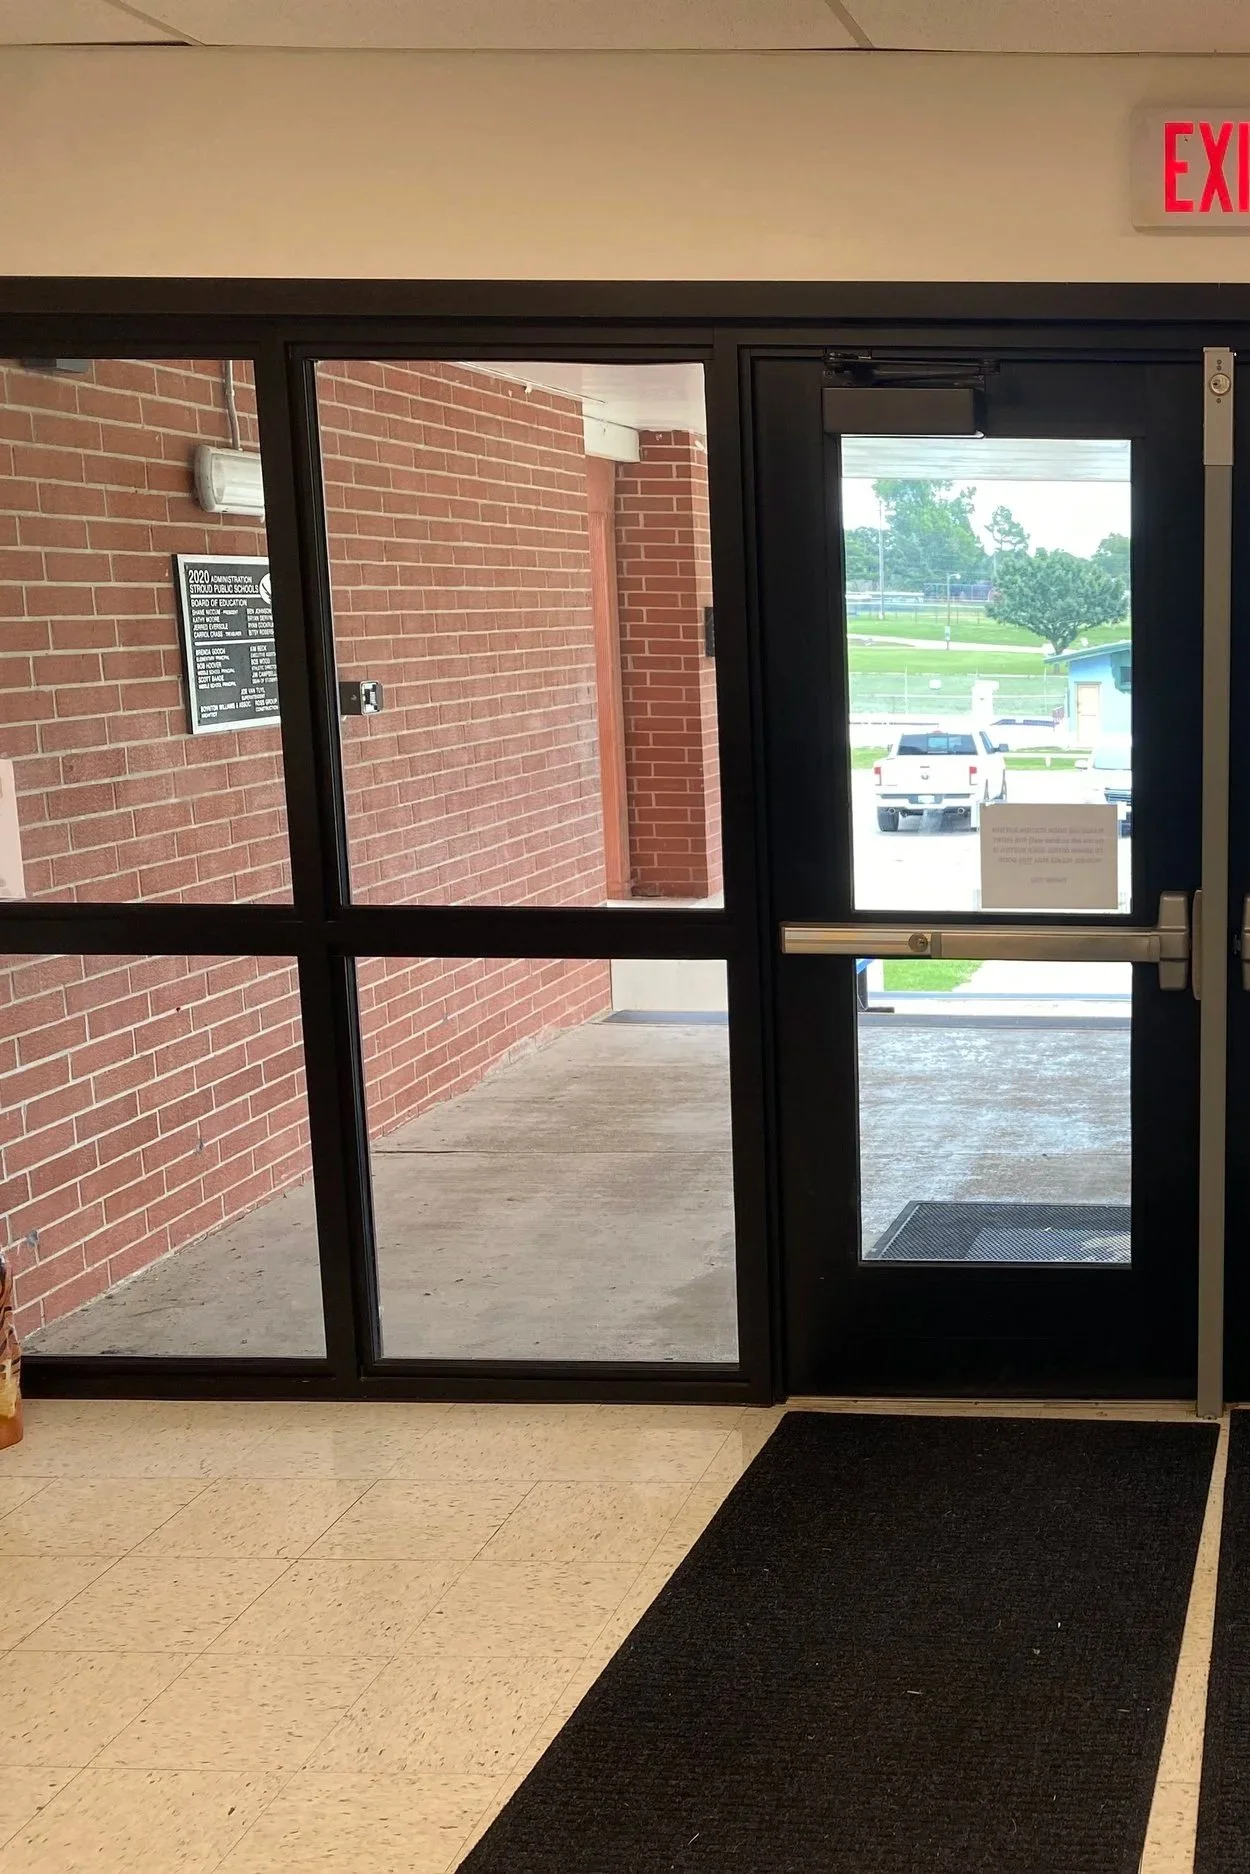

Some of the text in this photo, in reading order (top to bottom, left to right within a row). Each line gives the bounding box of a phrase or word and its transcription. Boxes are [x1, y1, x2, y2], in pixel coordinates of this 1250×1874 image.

[189, 570, 209, 584] 2020
[190, 585, 258, 593] STROUD PUBLIC SCHOOLS
